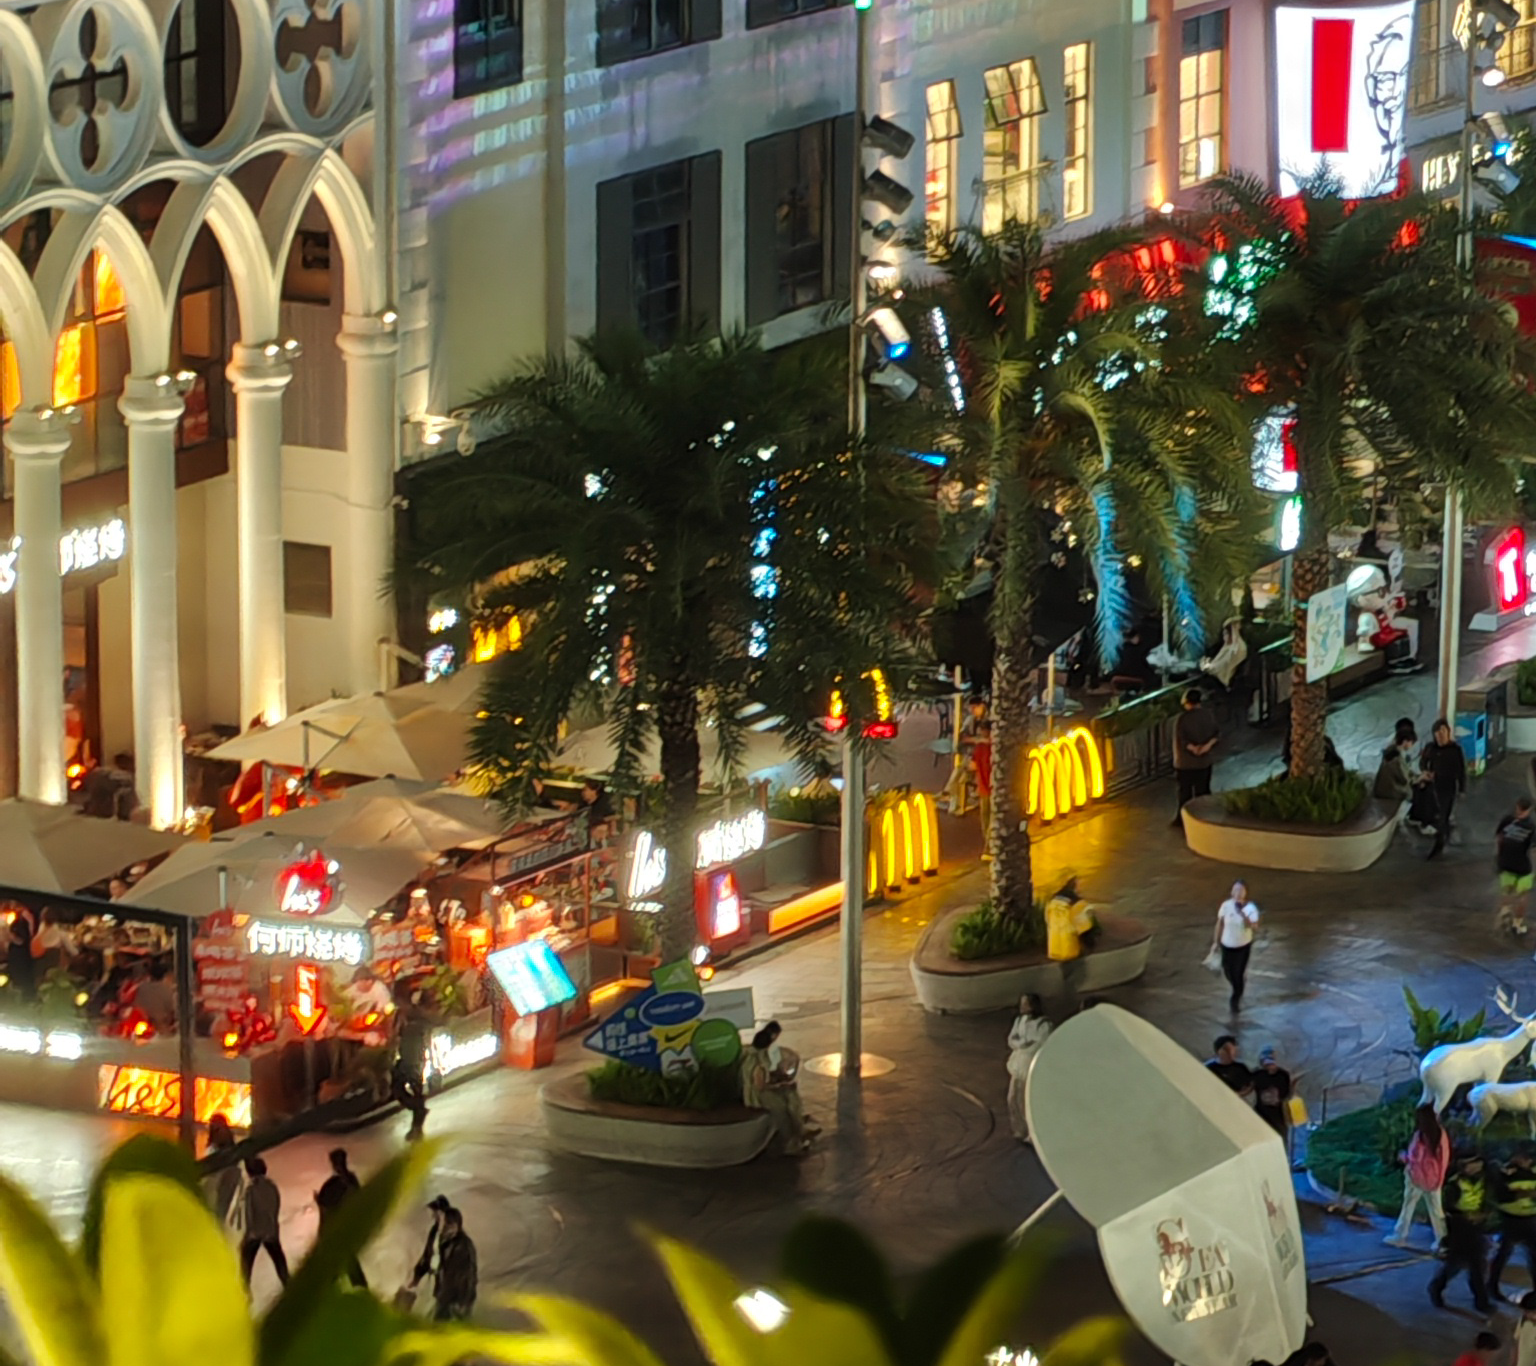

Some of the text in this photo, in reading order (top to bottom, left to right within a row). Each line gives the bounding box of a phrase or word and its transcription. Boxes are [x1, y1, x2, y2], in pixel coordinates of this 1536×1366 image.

[59, 519, 125, 576] 师烧烤
[247, 920, 365, 965] 何师烧烤
